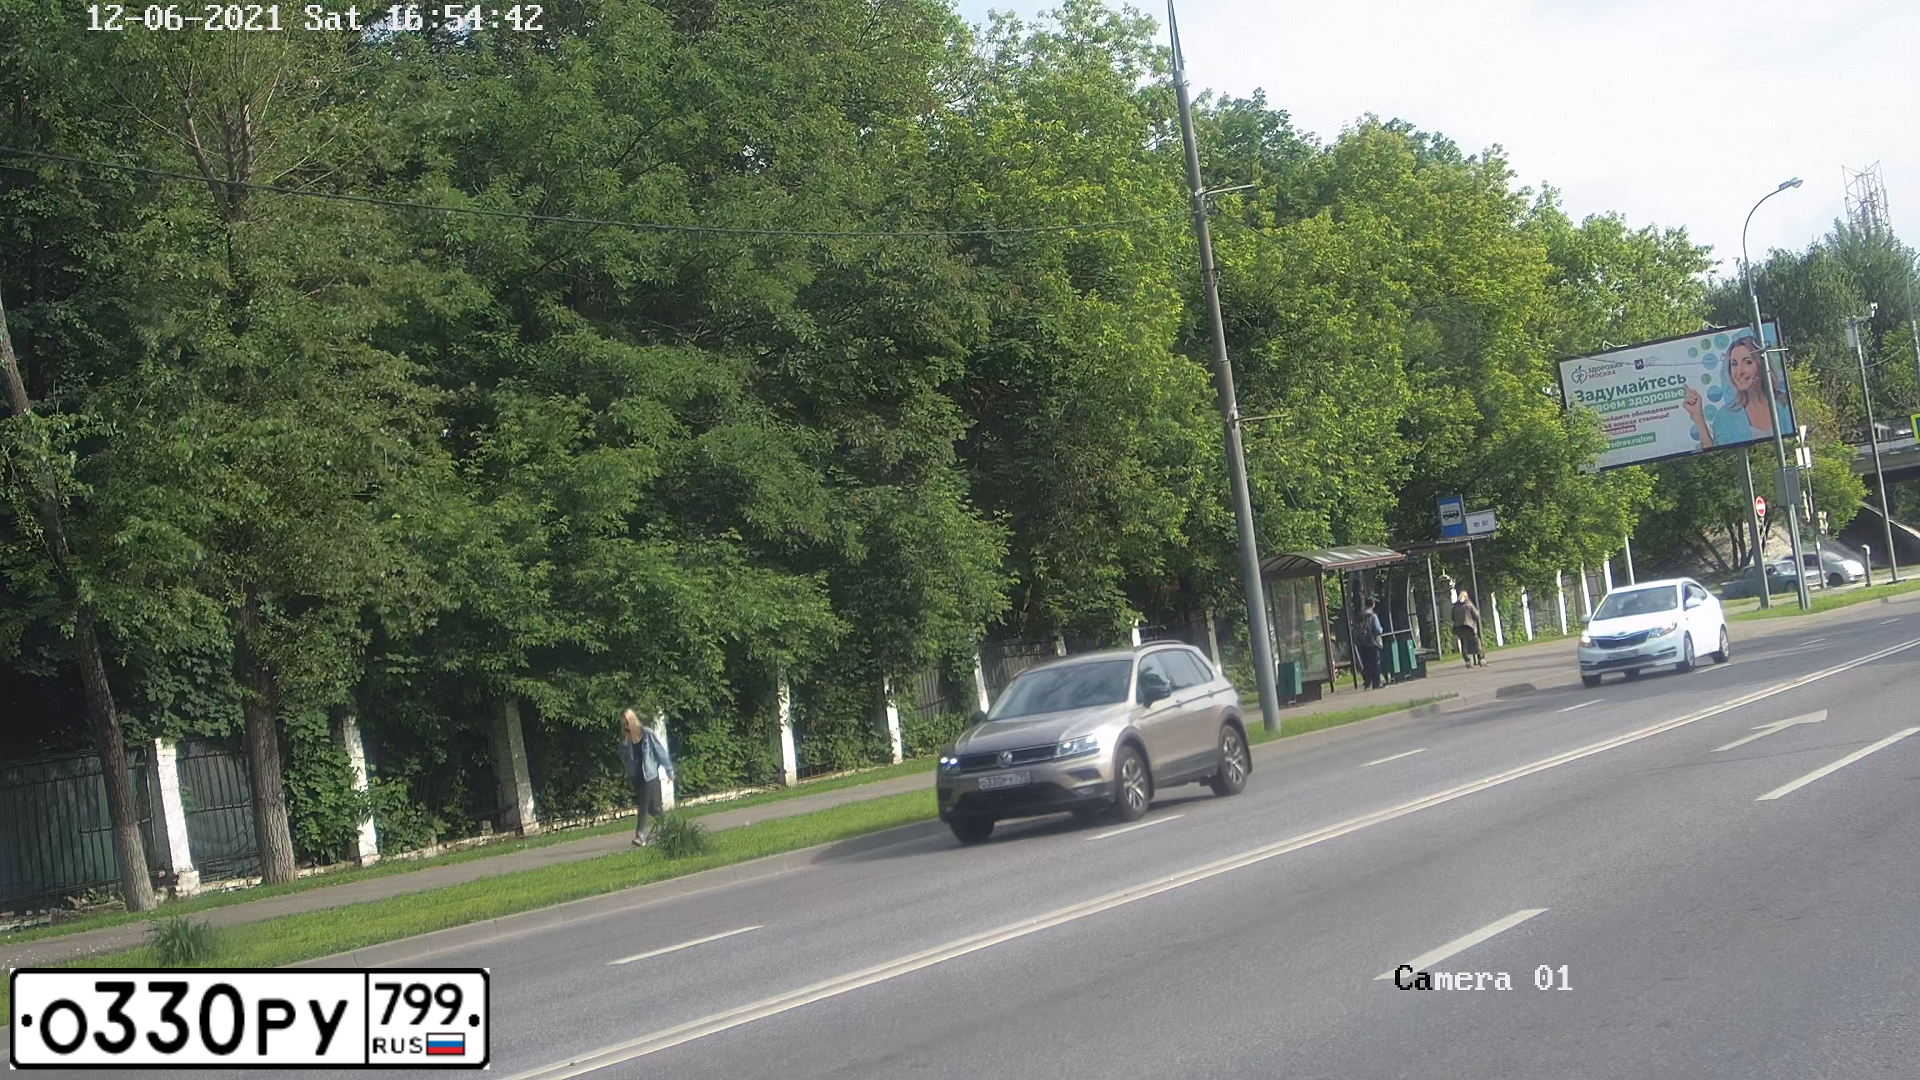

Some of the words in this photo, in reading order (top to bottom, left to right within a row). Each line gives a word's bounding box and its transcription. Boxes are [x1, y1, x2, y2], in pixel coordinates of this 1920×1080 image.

[1574, 374, 1687, 402] Задумайтесь
[1627, 388, 1685, 407] здоровье
[1609, 435, 1655, 449] zdrav.ru/zm
